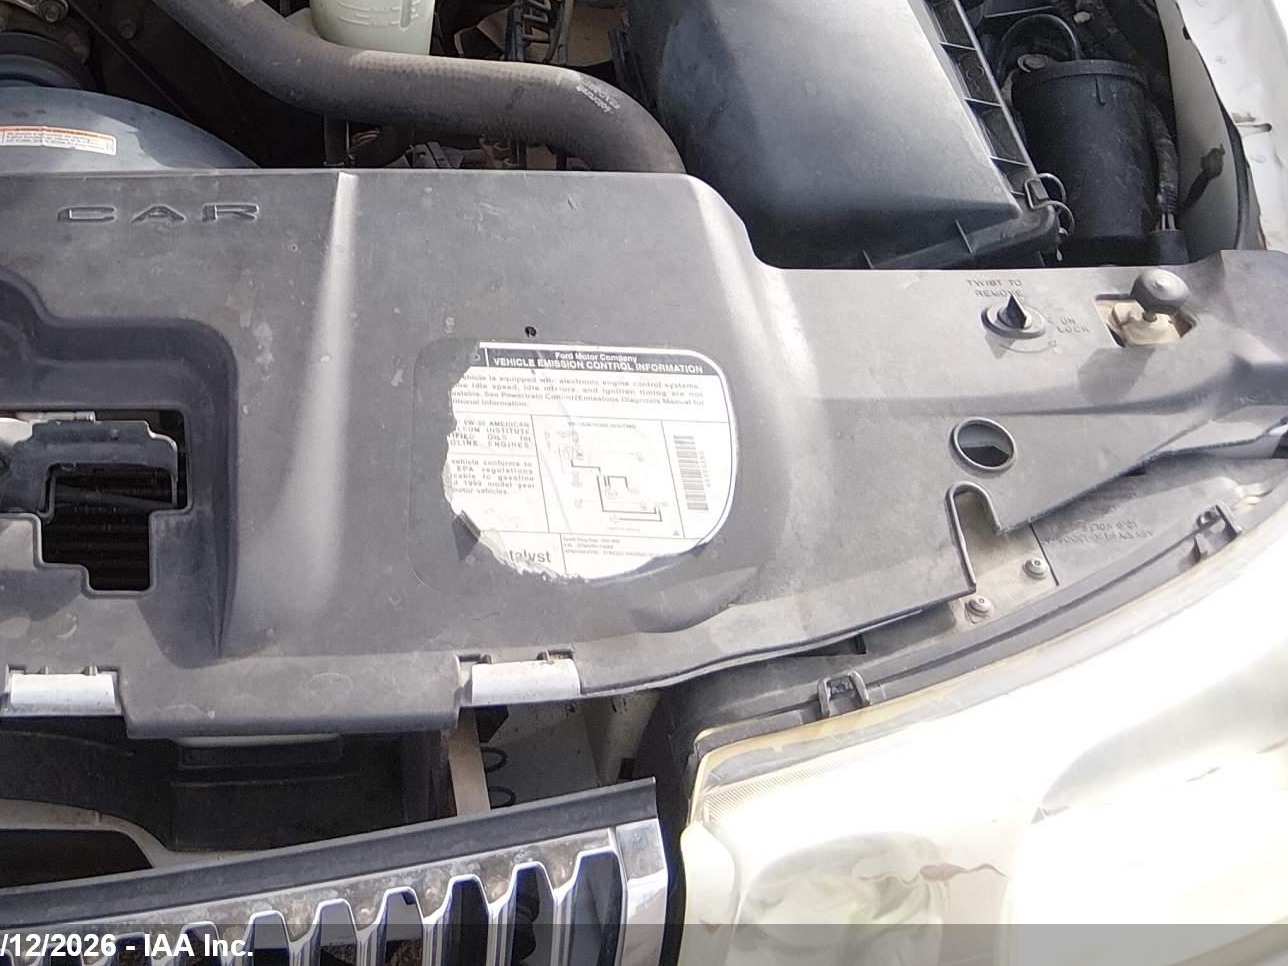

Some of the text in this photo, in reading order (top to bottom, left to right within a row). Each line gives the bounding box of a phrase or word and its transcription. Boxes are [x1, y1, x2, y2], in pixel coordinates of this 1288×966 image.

[57, 203, 261, 224] CAR
[493, 357, 704, 374] VEHICLE EMISSION CONTROL INFORMATION
[555, 351, 638, 363] Ford Motor Company
